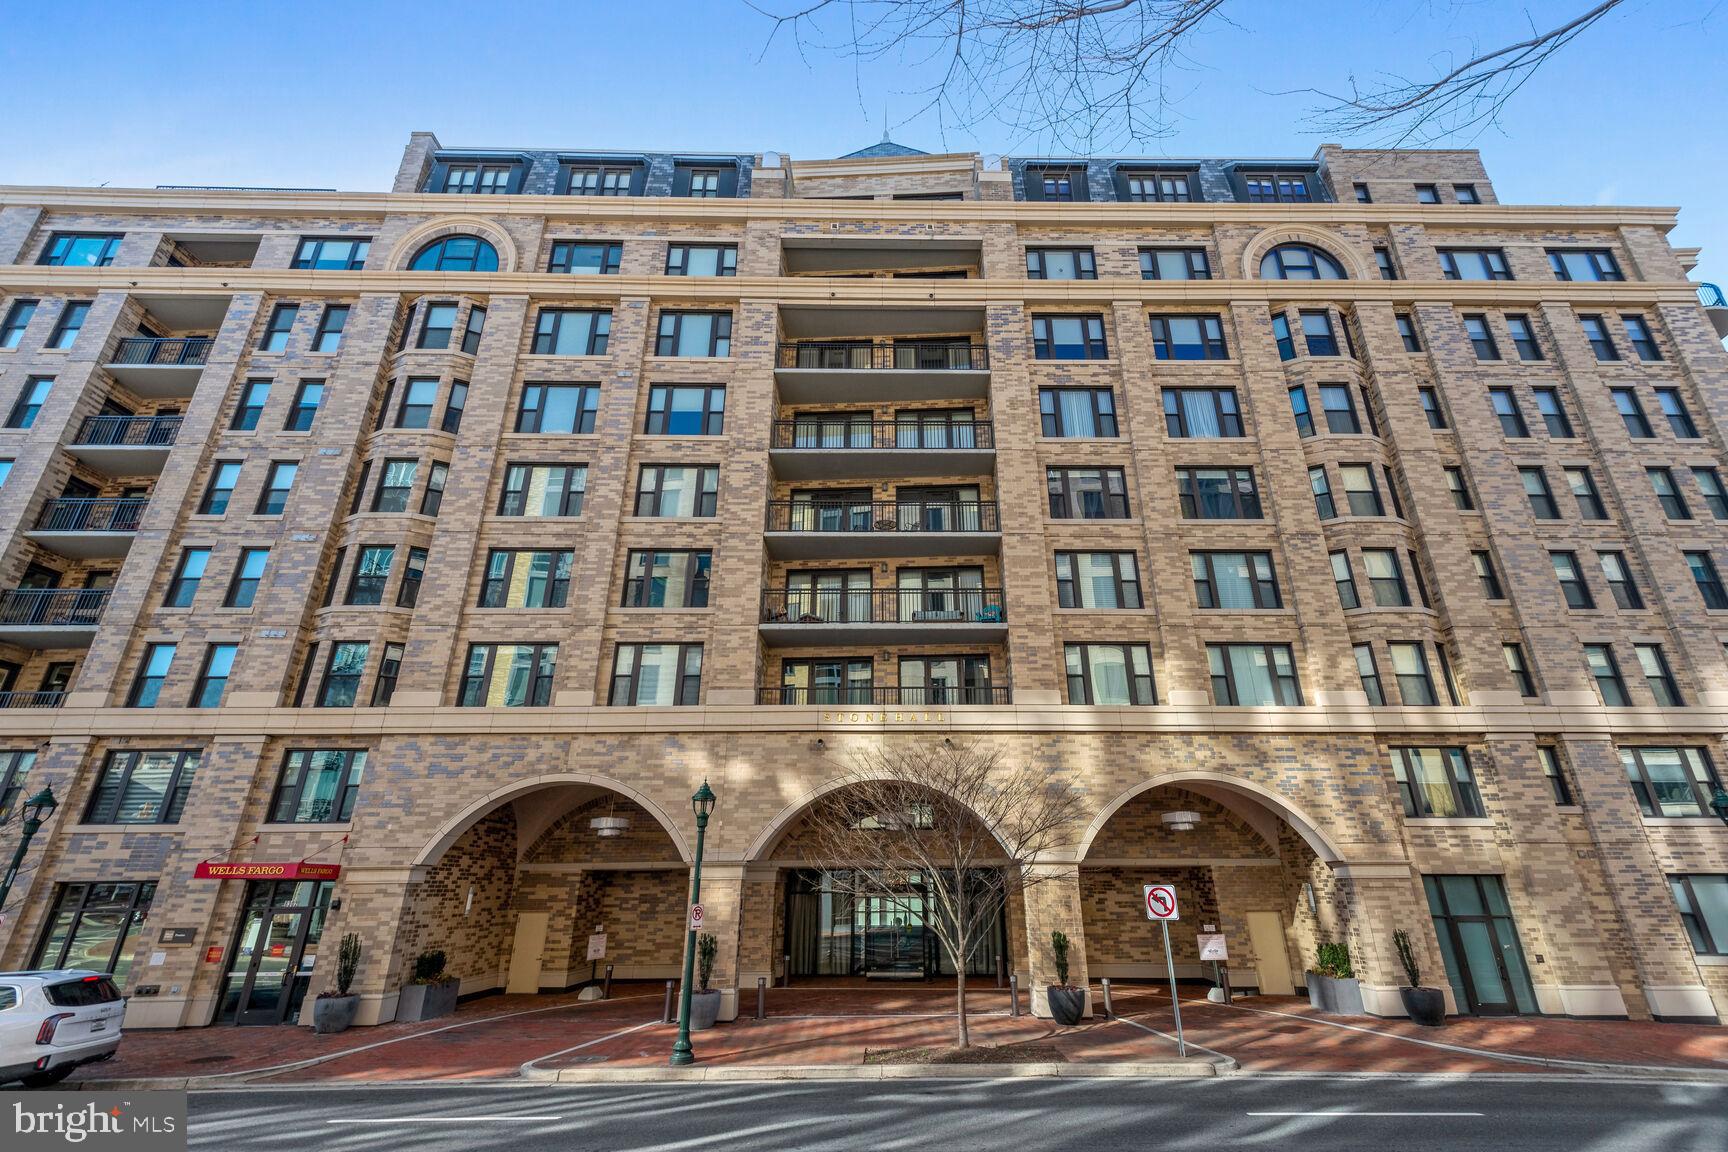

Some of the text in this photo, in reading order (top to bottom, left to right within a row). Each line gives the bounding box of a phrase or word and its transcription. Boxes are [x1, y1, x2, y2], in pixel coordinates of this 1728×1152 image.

[824, 712, 945, 722] STONEHALL
[208, 866, 285, 875] WELLS FARGO
